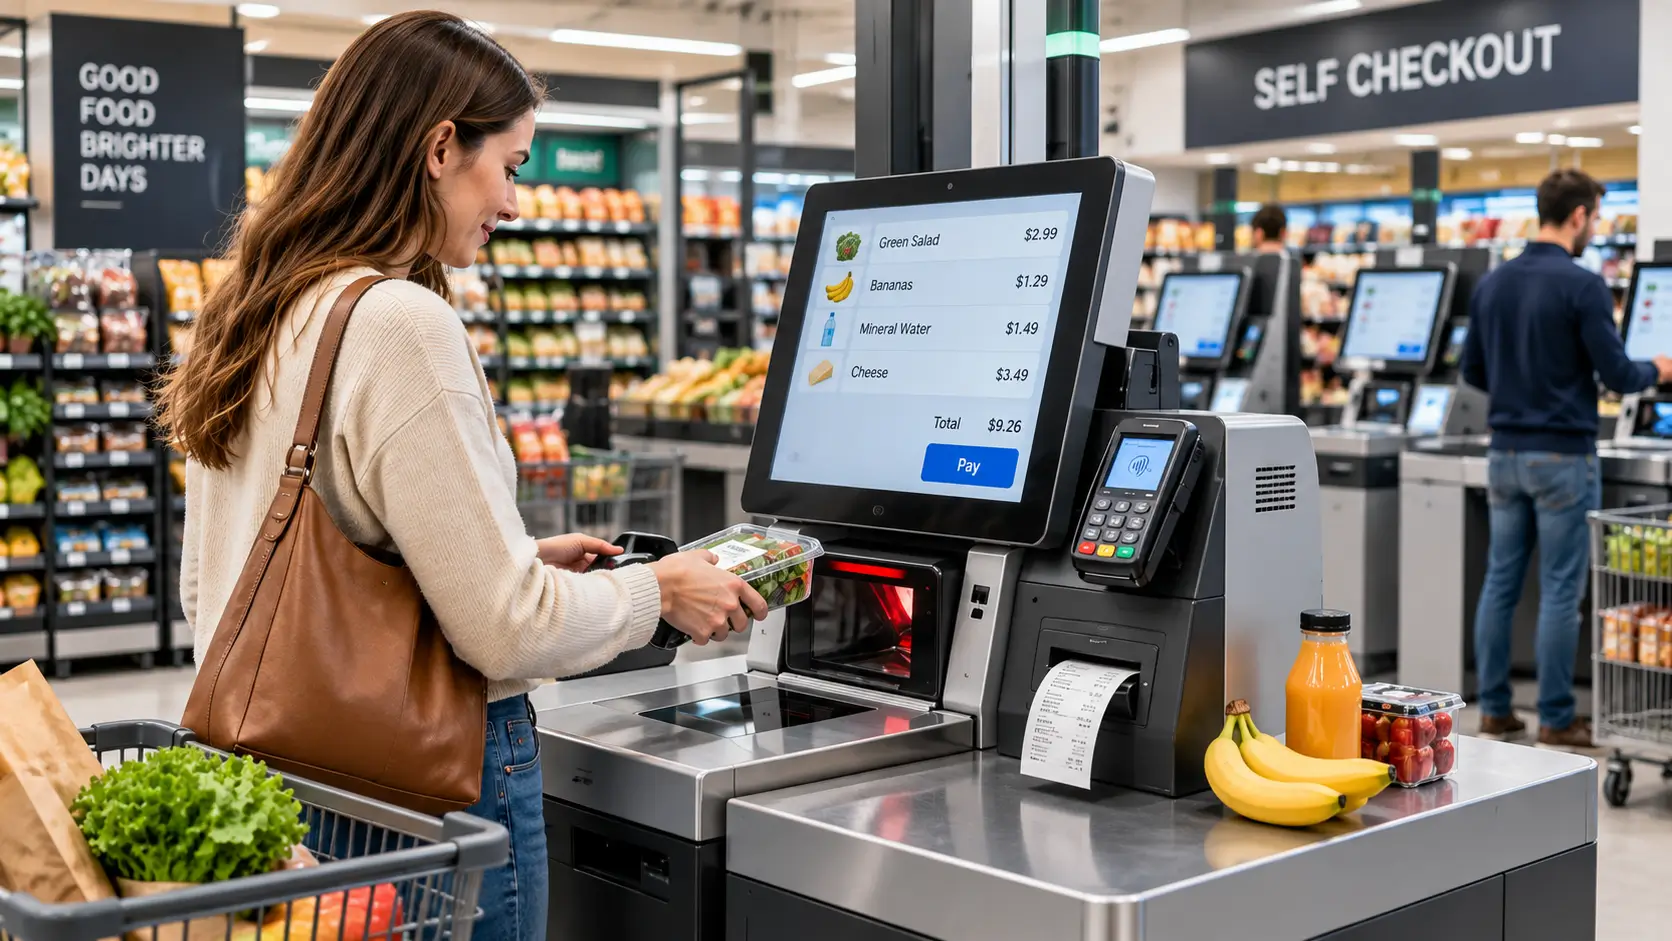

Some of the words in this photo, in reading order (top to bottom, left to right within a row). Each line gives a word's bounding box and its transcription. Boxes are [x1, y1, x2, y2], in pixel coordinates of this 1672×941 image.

[79, 62, 159, 94] GOOD
[1254, 58, 1339, 110] SELF
[1346, 25, 1561, 97] CHECKOUT
[80, 96, 156, 127] FOOD
[81, 131, 206, 162] BRIGHTER
[81, 163, 147, 194] DAYS
[879, 235, 909, 249] Green
[911, 233, 941, 248] Salad
[1024, 227, 1058, 242] $2.99
[870, 279, 913, 292] Bananas
[1015, 274, 1049, 289] $1.29
[859, 322, 898, 335] Mineral
[900, 322, 932, 335] Water
[1005, 321, 1039, 336] $1.49
[851, 365, 889, 379] Cheese
[995, 367, 1029, 382] $3.49
[934, 416, 962, 430] Total
[987, 417, 1022, 433] $9.26
[957, 457, 981, 476] Pay
